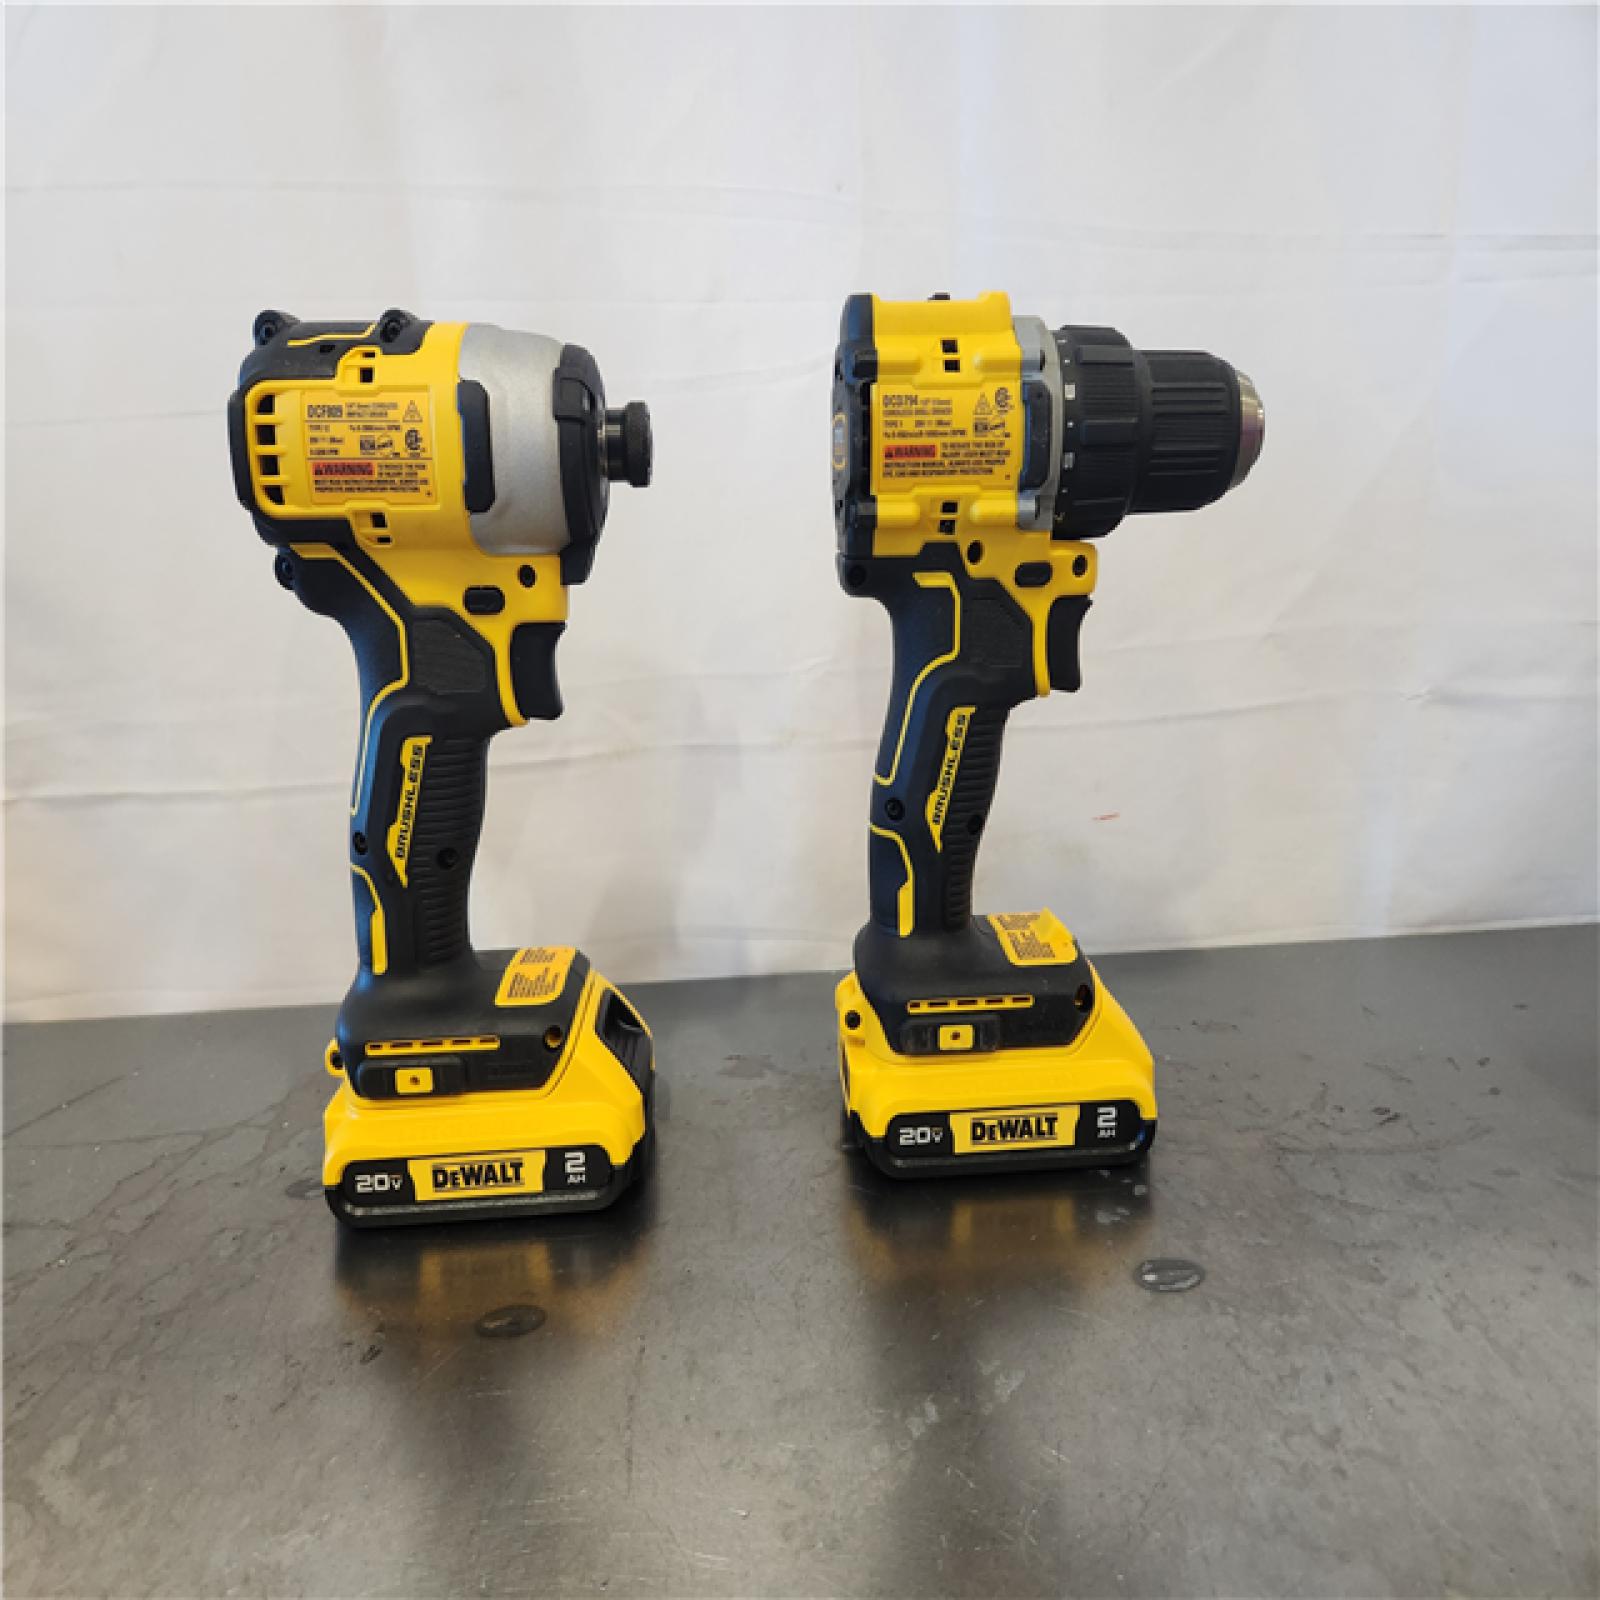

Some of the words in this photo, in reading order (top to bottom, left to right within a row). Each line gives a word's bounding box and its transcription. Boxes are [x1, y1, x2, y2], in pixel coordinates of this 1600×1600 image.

[894, 445, 936, 458] WARNING
[323, 463, 373, 476] WARNING
[933, 714, 966, 826] BRUSHLESS
[395, 744, 424, 859] BRUSHLESS
[1097, 1106, 1118, 1128] 2
[899, 1127, 944, 1147] 20V
[564, 1151, 587, 1174] 2
[354, 1173, 403, 1195] 20V
